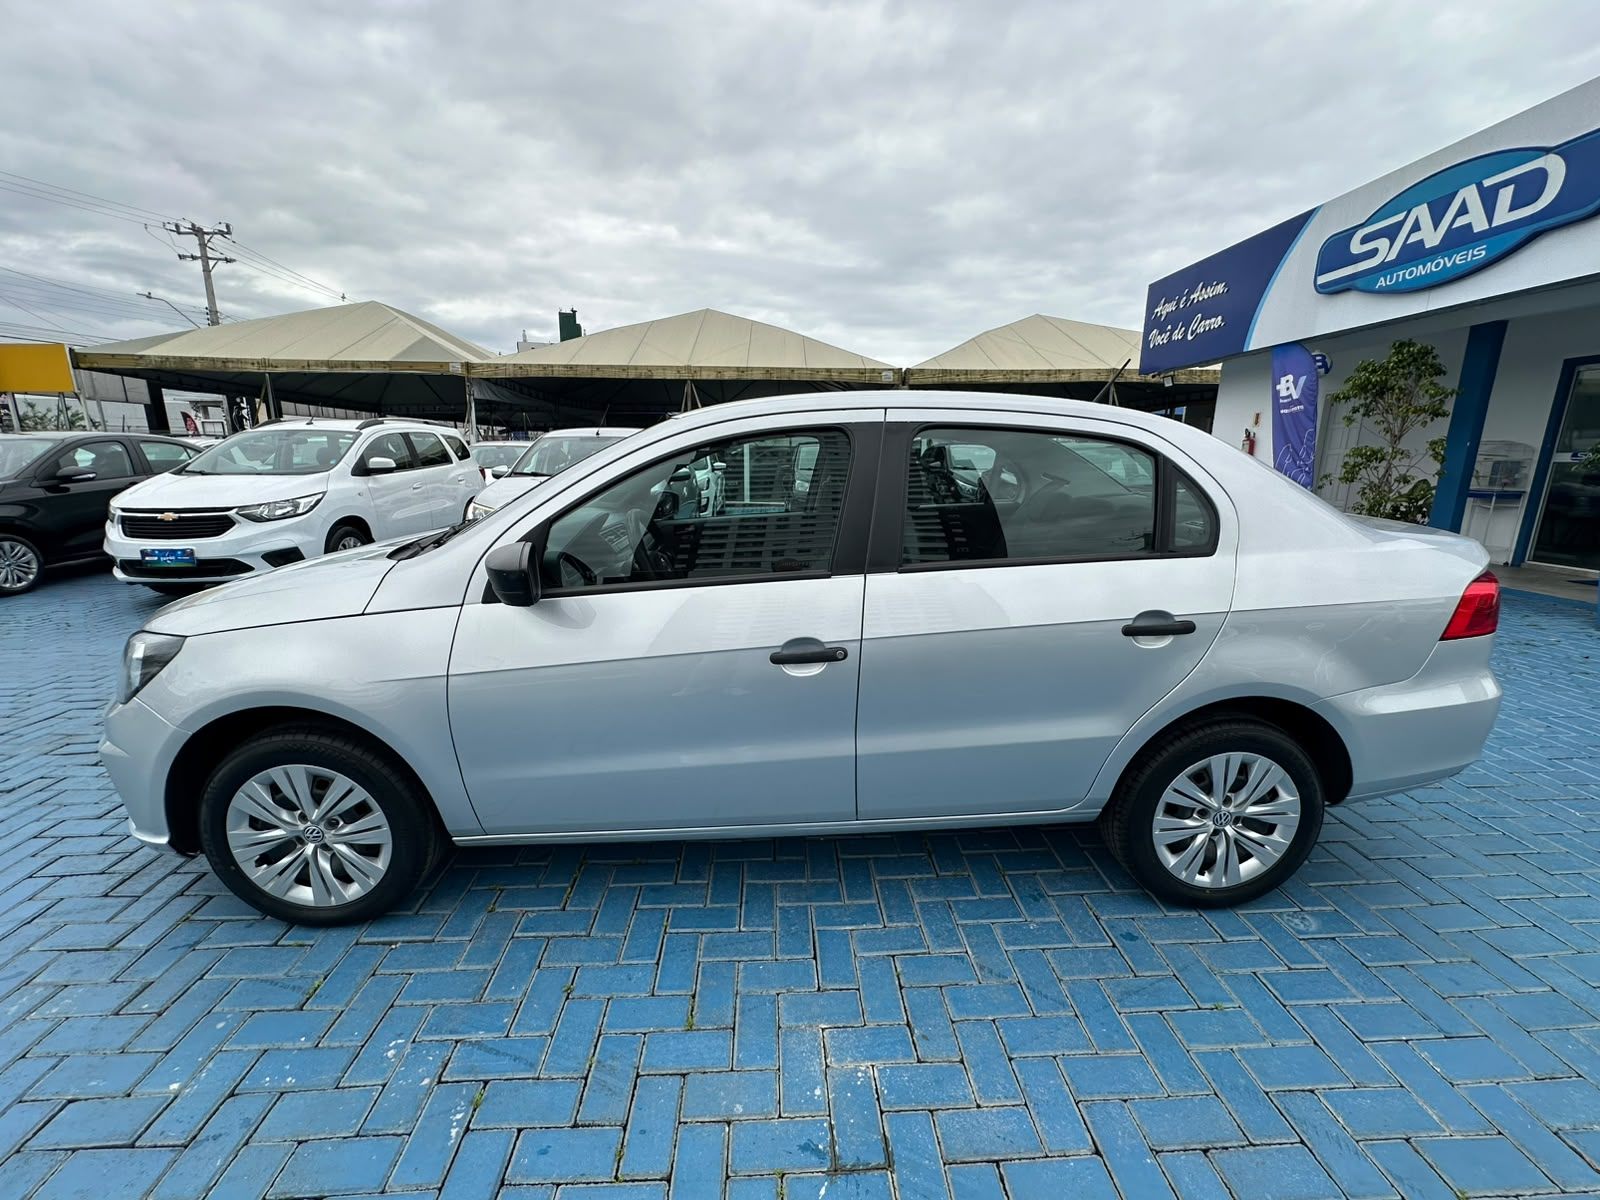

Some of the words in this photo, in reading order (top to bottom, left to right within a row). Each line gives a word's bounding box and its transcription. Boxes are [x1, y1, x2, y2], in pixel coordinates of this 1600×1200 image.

[1317, 152, 1567, 285] SAAD
[1375, 244, 1488, 289] AUTOMÓVEIS
[1151, 296, 1179, 321] Aqui
[1180, 288, 1189, 309] é
[1148, 324, 1172, 349] Você
[1171, 321, 1186, 341] de
[1276, 374, 1307, 400] BV
